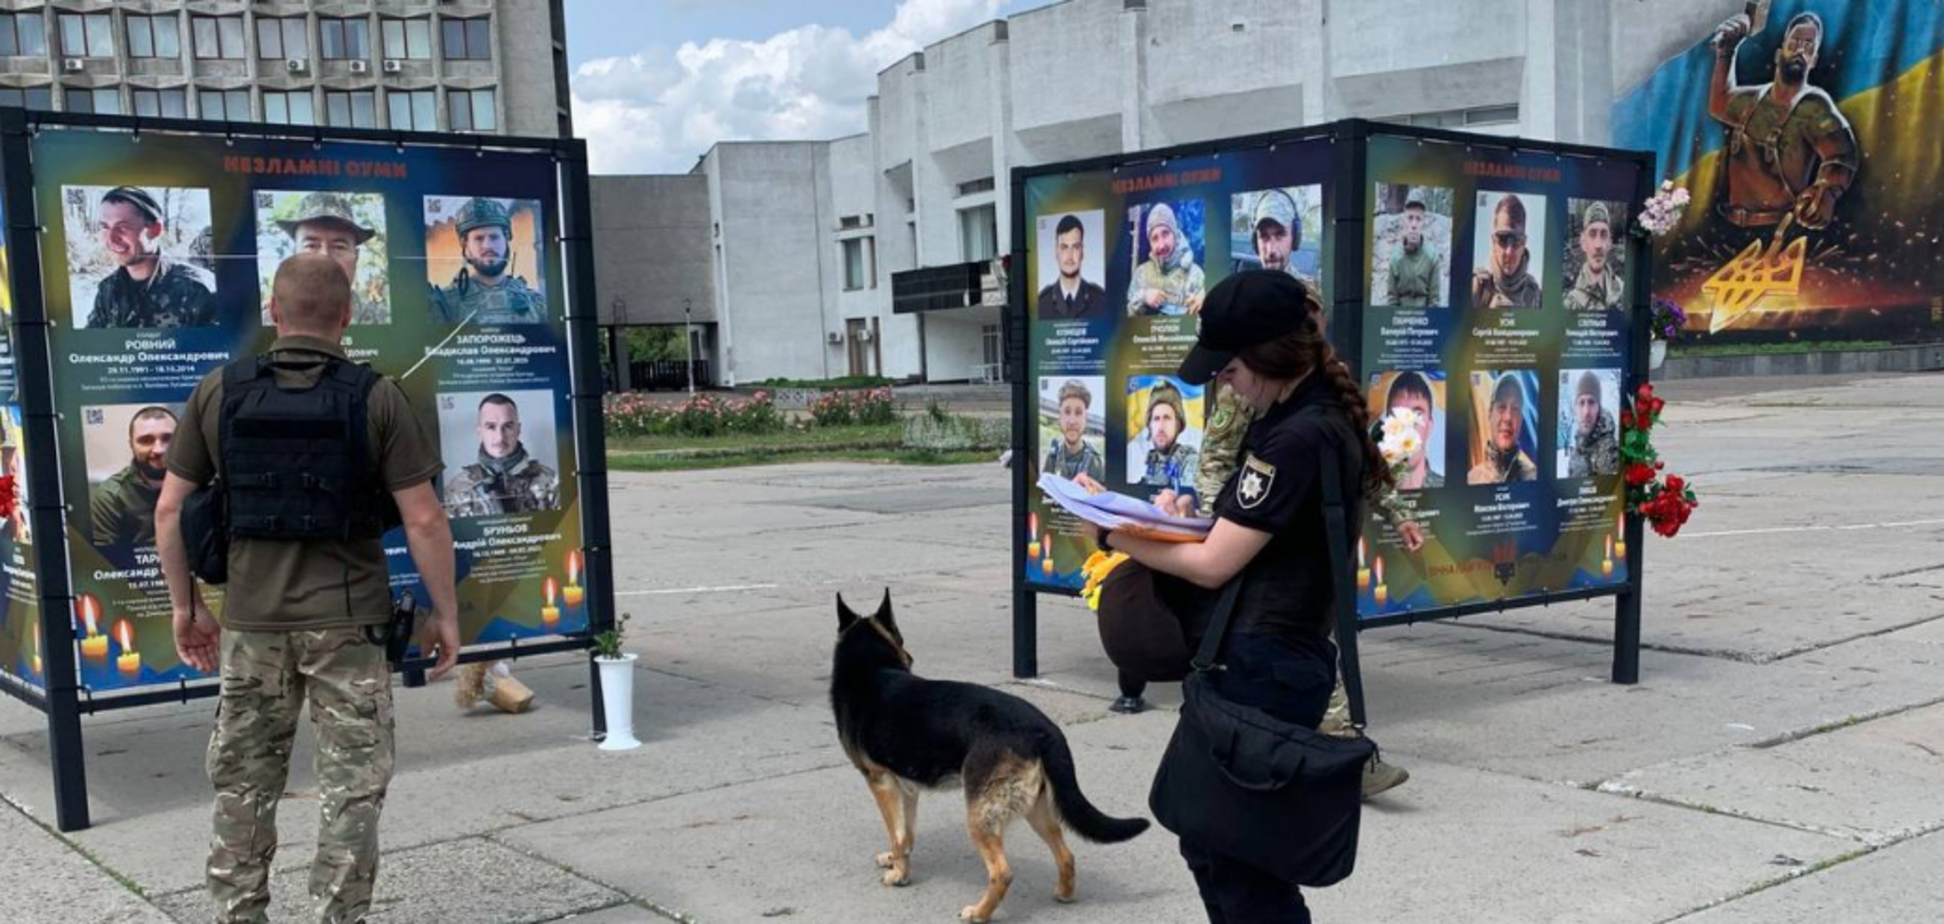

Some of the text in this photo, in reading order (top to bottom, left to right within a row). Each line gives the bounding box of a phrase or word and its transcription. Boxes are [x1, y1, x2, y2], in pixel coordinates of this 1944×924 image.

[224, 156, 340, 176] НЕЗЛАМНІ
[125, 339, 177, 350] РОВНИЙ
[456, 334, 526, 345] ЗАПОРОЖЕЦЬ
[481, 345, 556, 356] Олександрович
[69, 351, 230, 364] Олександр Олександрович
[94, 567, 159, 581] Олександр
